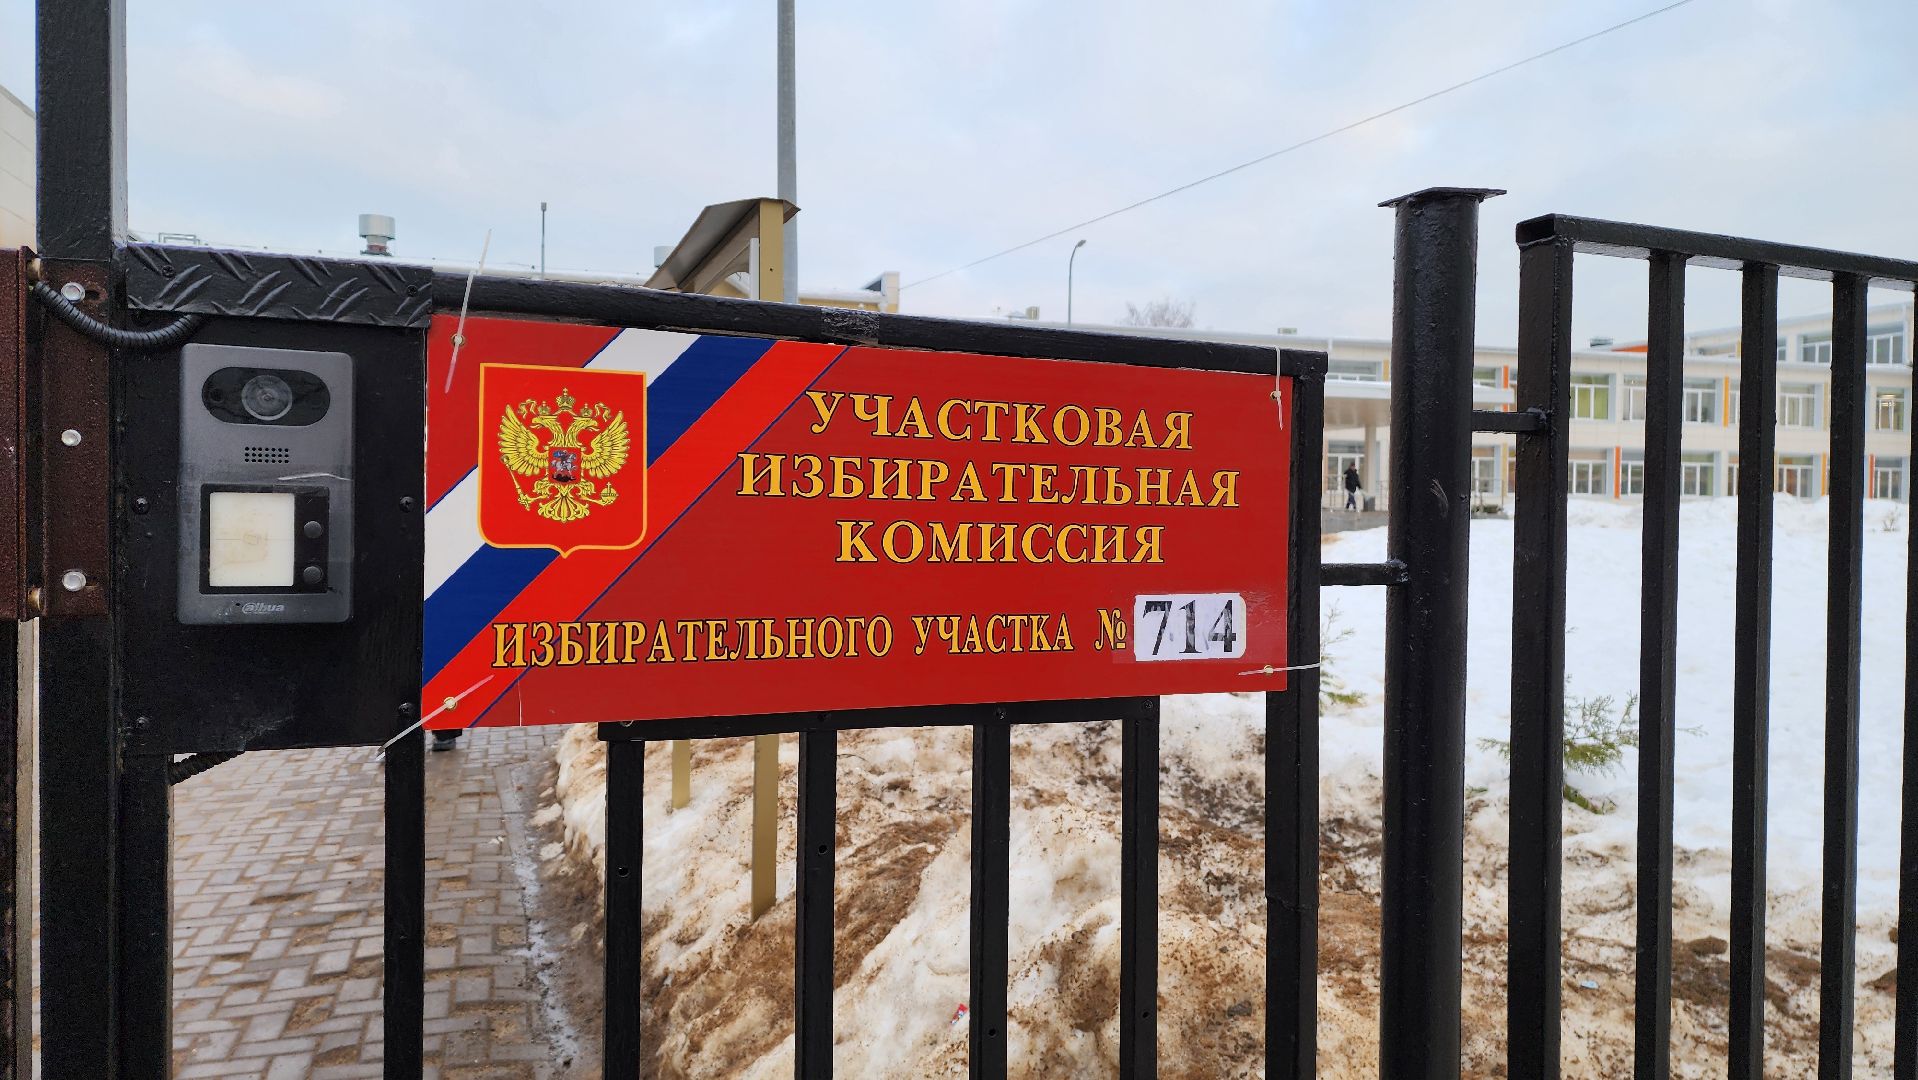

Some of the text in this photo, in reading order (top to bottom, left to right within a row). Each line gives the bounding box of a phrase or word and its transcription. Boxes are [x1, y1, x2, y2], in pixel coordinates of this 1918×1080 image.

[805, 390, 1195, 450] УЧАСТКОВАЯ
[736, 451, 1240, 508] ИЗБИРАТЕЛЬНАЯ
[835, 519, 1166, 565] КОМИССИЯ
[491, 599, 1237, 668] ИЗБИРАТЕЛЬНОГО УЧАСТКА № 714
